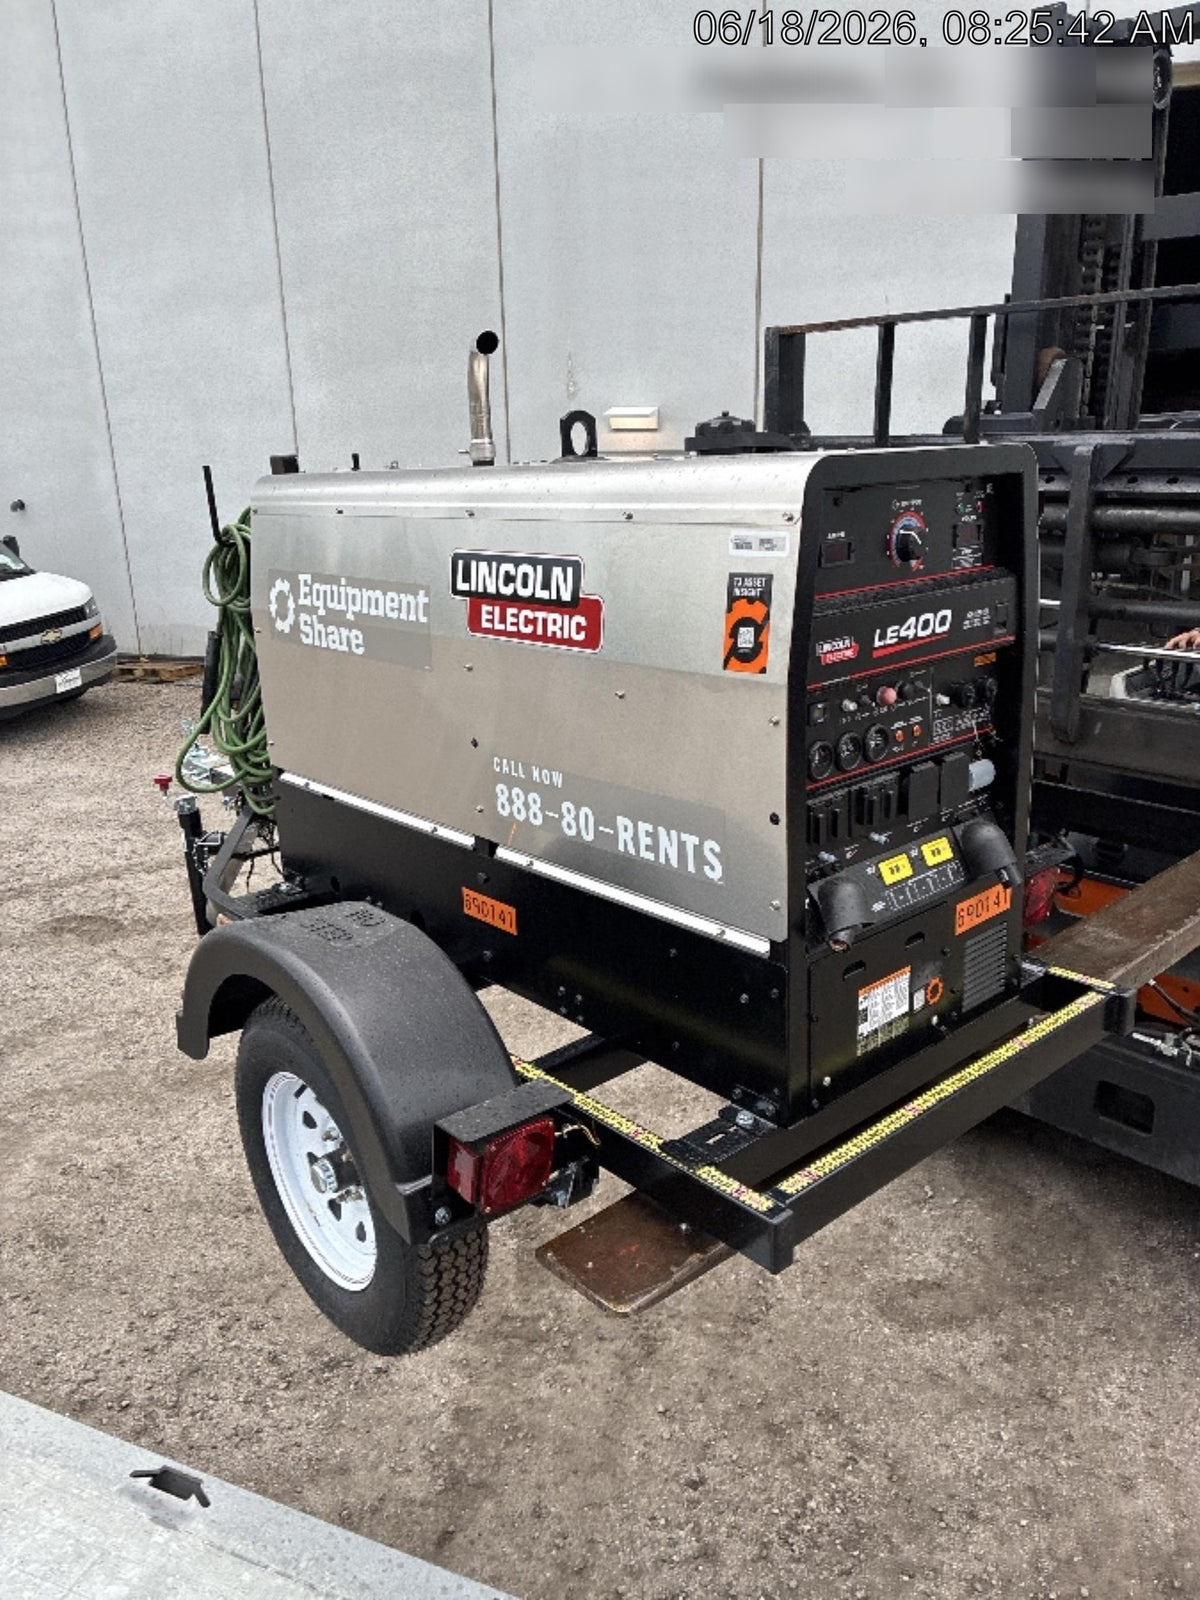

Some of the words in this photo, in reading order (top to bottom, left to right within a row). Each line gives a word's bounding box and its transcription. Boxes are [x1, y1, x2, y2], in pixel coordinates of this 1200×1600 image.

[299, 573, 429, 623] Equipment
[456, 559, 573, 602] LINCOLN
[299, 614, 365, 655] Share
[480, 604, 587, 641] ELECTRIC
[872, 608, 953, 648] LE400
[493, 756, 526, 779] CALL
[532, 765, 563, 788] NOW
[495, 782, 723, 881] 888-80-RENTS
